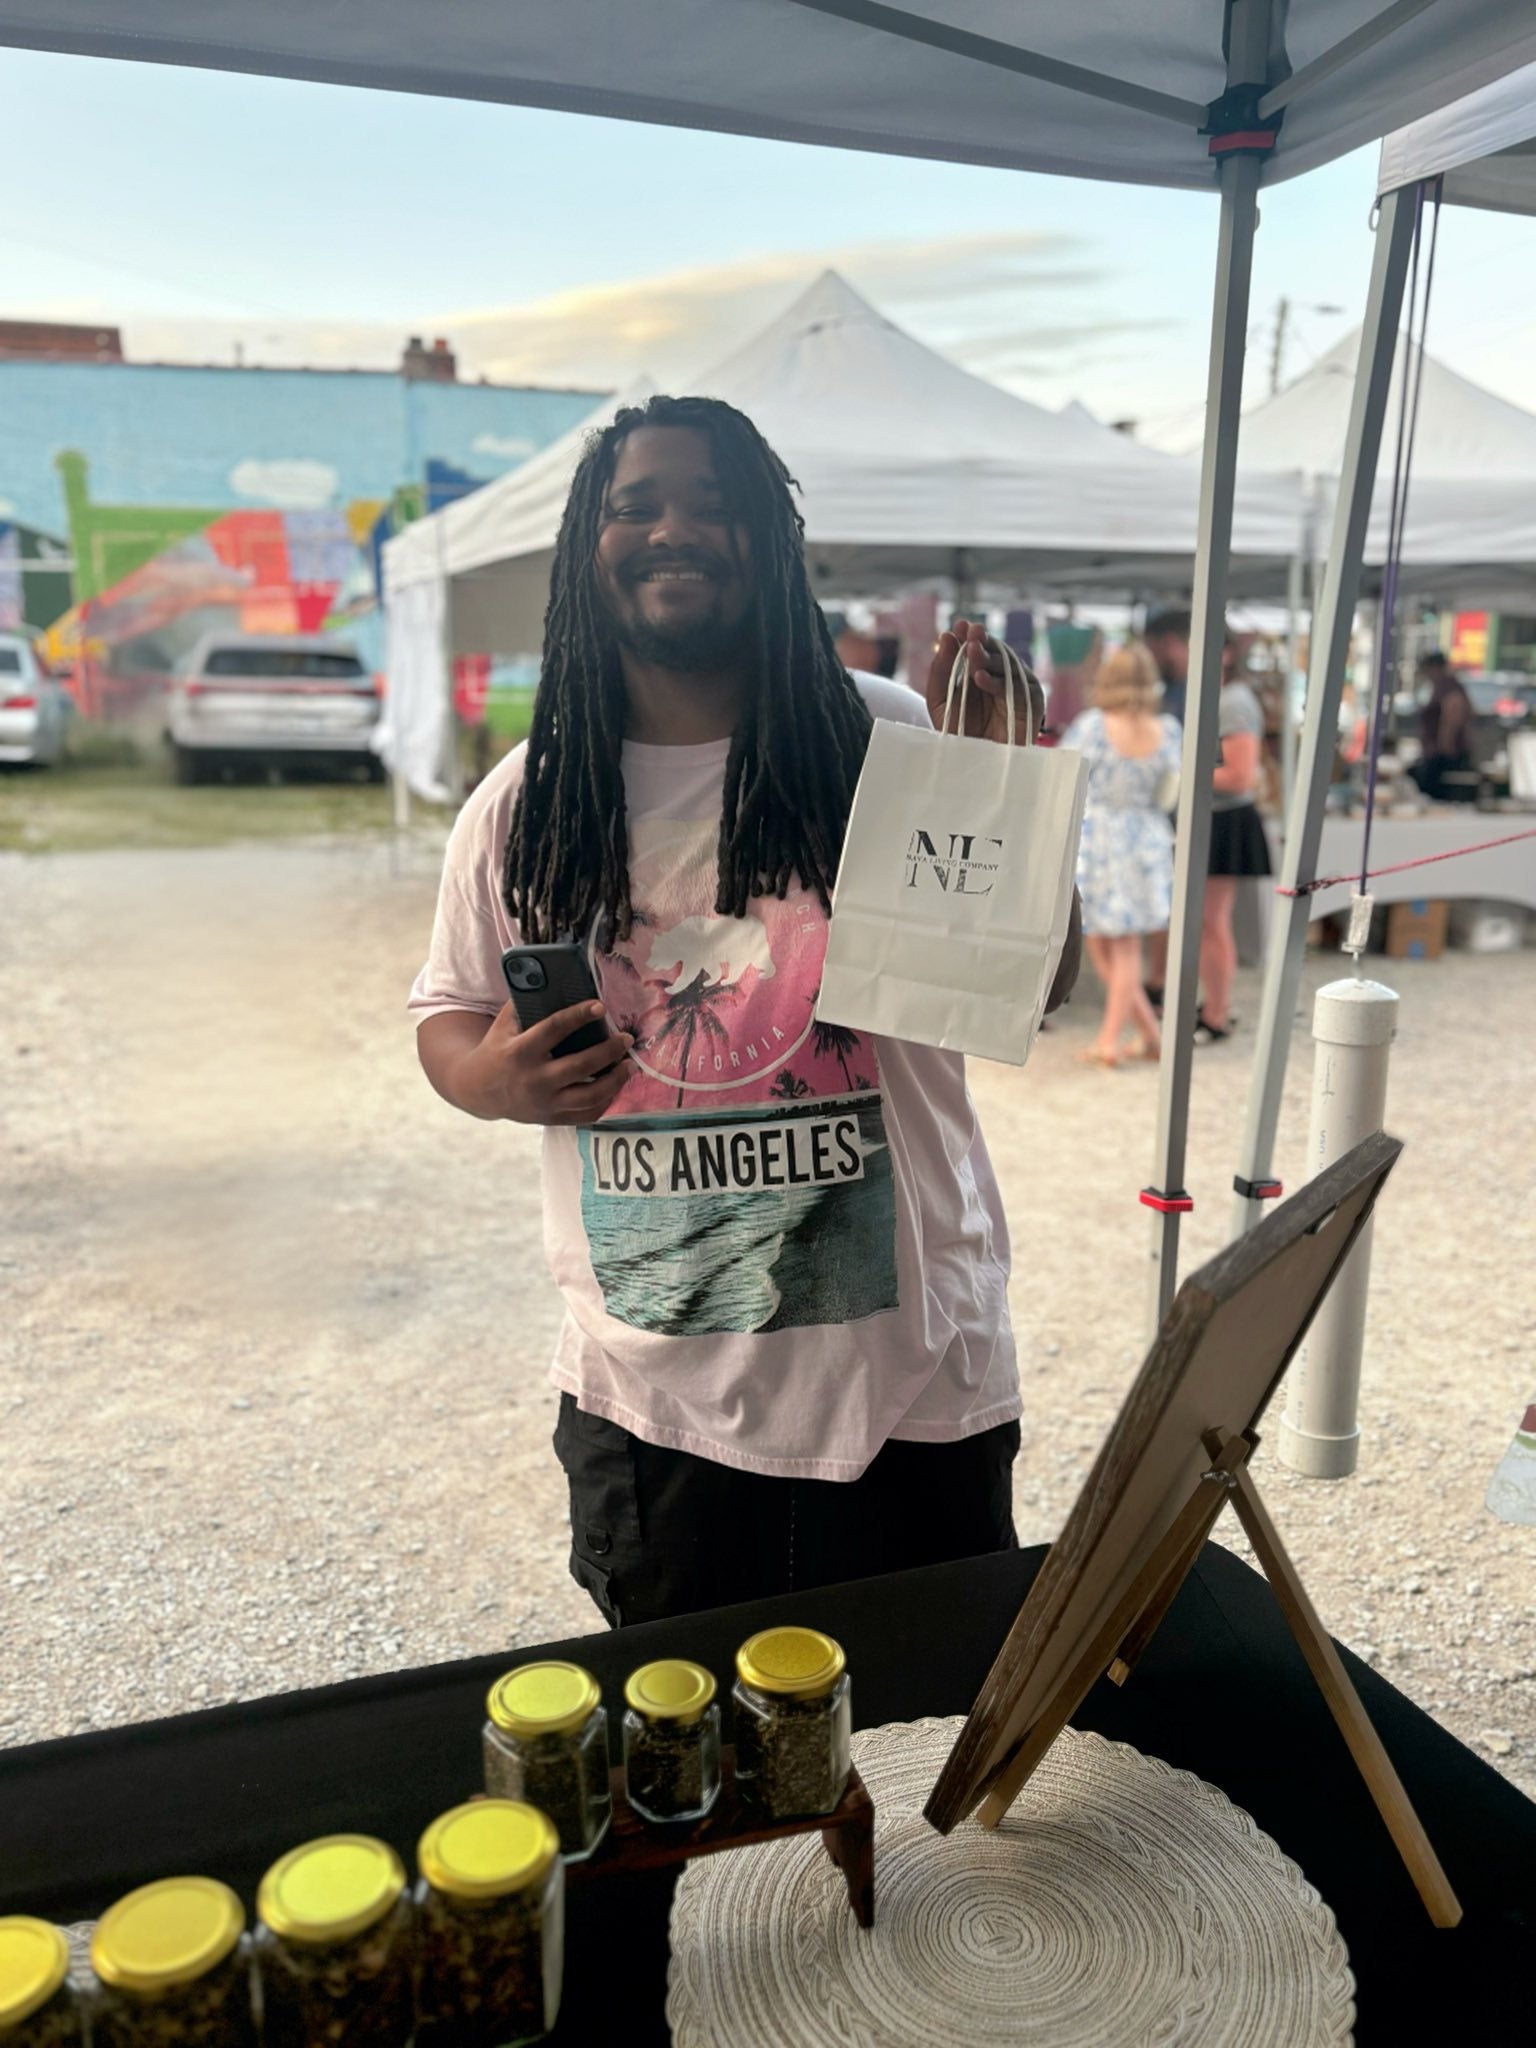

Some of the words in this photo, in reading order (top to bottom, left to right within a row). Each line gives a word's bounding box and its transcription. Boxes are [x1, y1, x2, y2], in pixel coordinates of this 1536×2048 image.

[959, 861, 999, 872] COMPANY
[645, 1025, 784, 1071] CALIFORNIA
[594, 1136, 656, 1192] LOS
[670, 1120, 860, 1192] ANGELES
